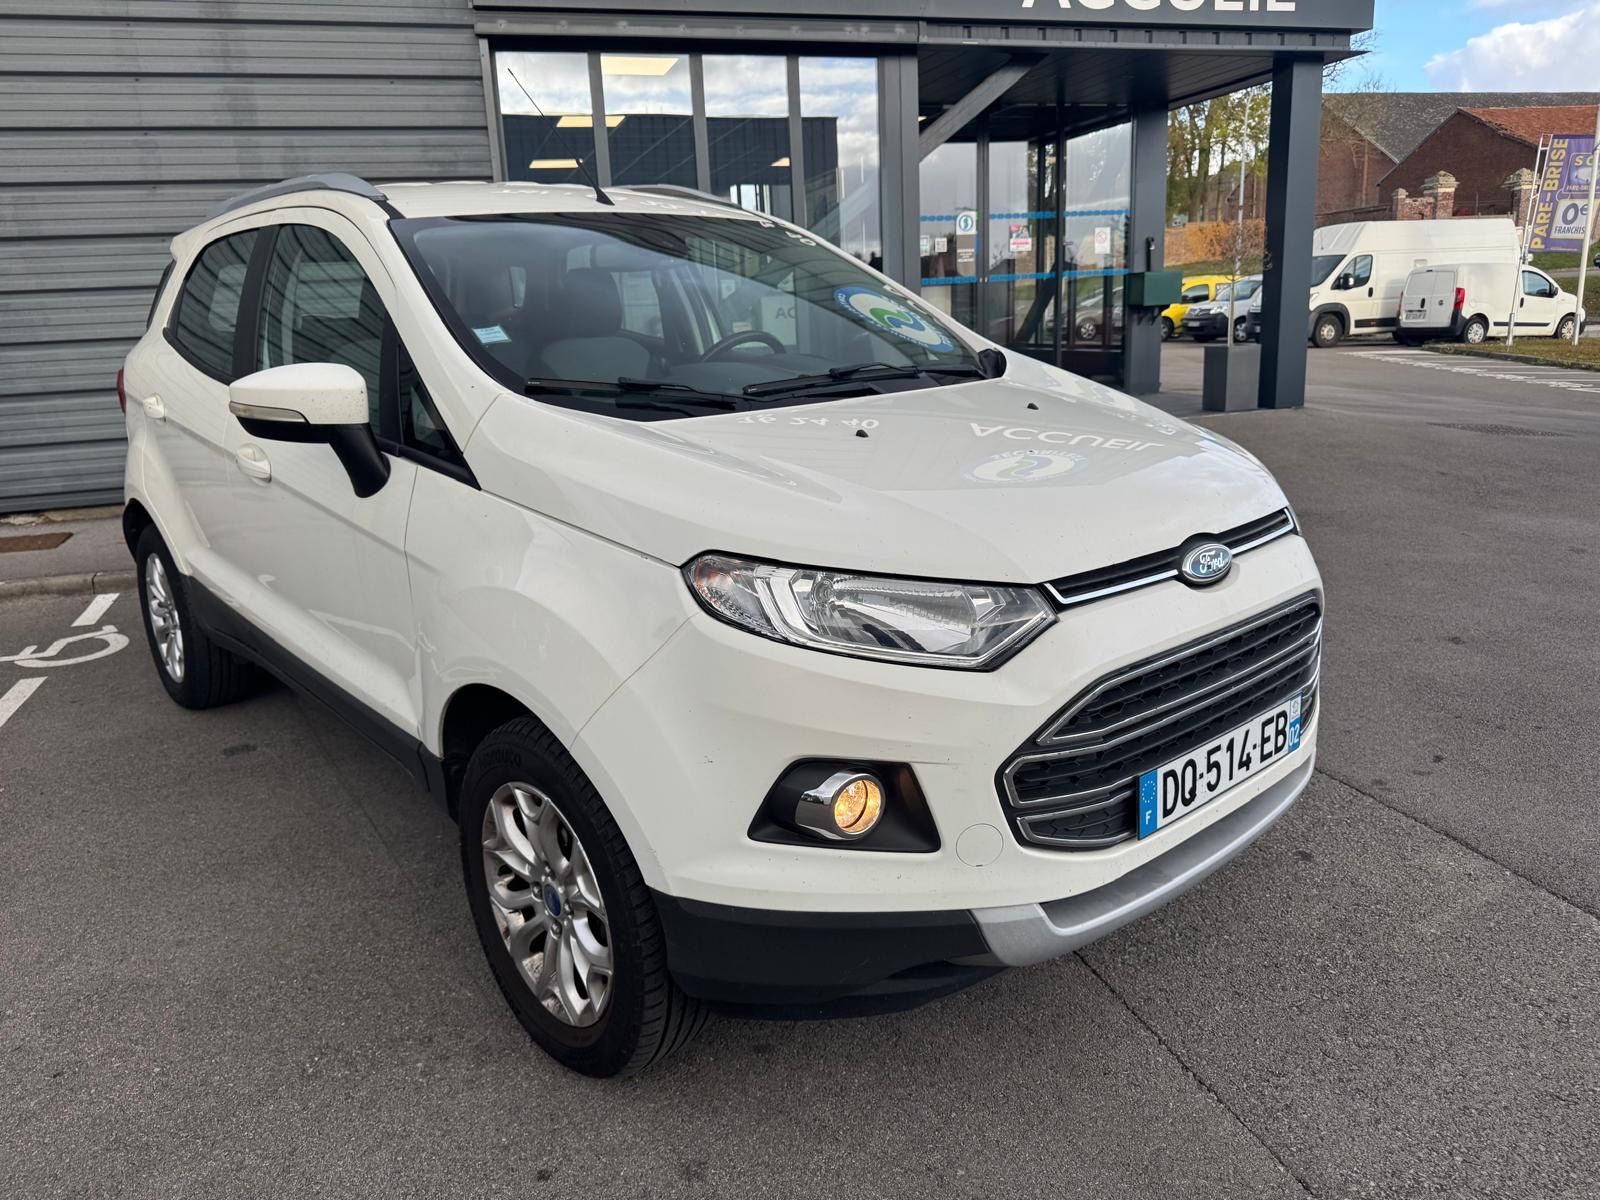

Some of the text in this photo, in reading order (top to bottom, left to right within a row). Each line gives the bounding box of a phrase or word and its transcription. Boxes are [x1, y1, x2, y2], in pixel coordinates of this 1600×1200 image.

[1530, 138, 1568, 249] PARE-BRISE
[1553, 225, 1585, 235] FRANCHIS
[1199, 549, 1225, 574] Ford
[1289, 724, 1300, 747] 02
[1162, 709, 1288, 819] DQ-514-EB
[1145, 810, 1152, 825] F
